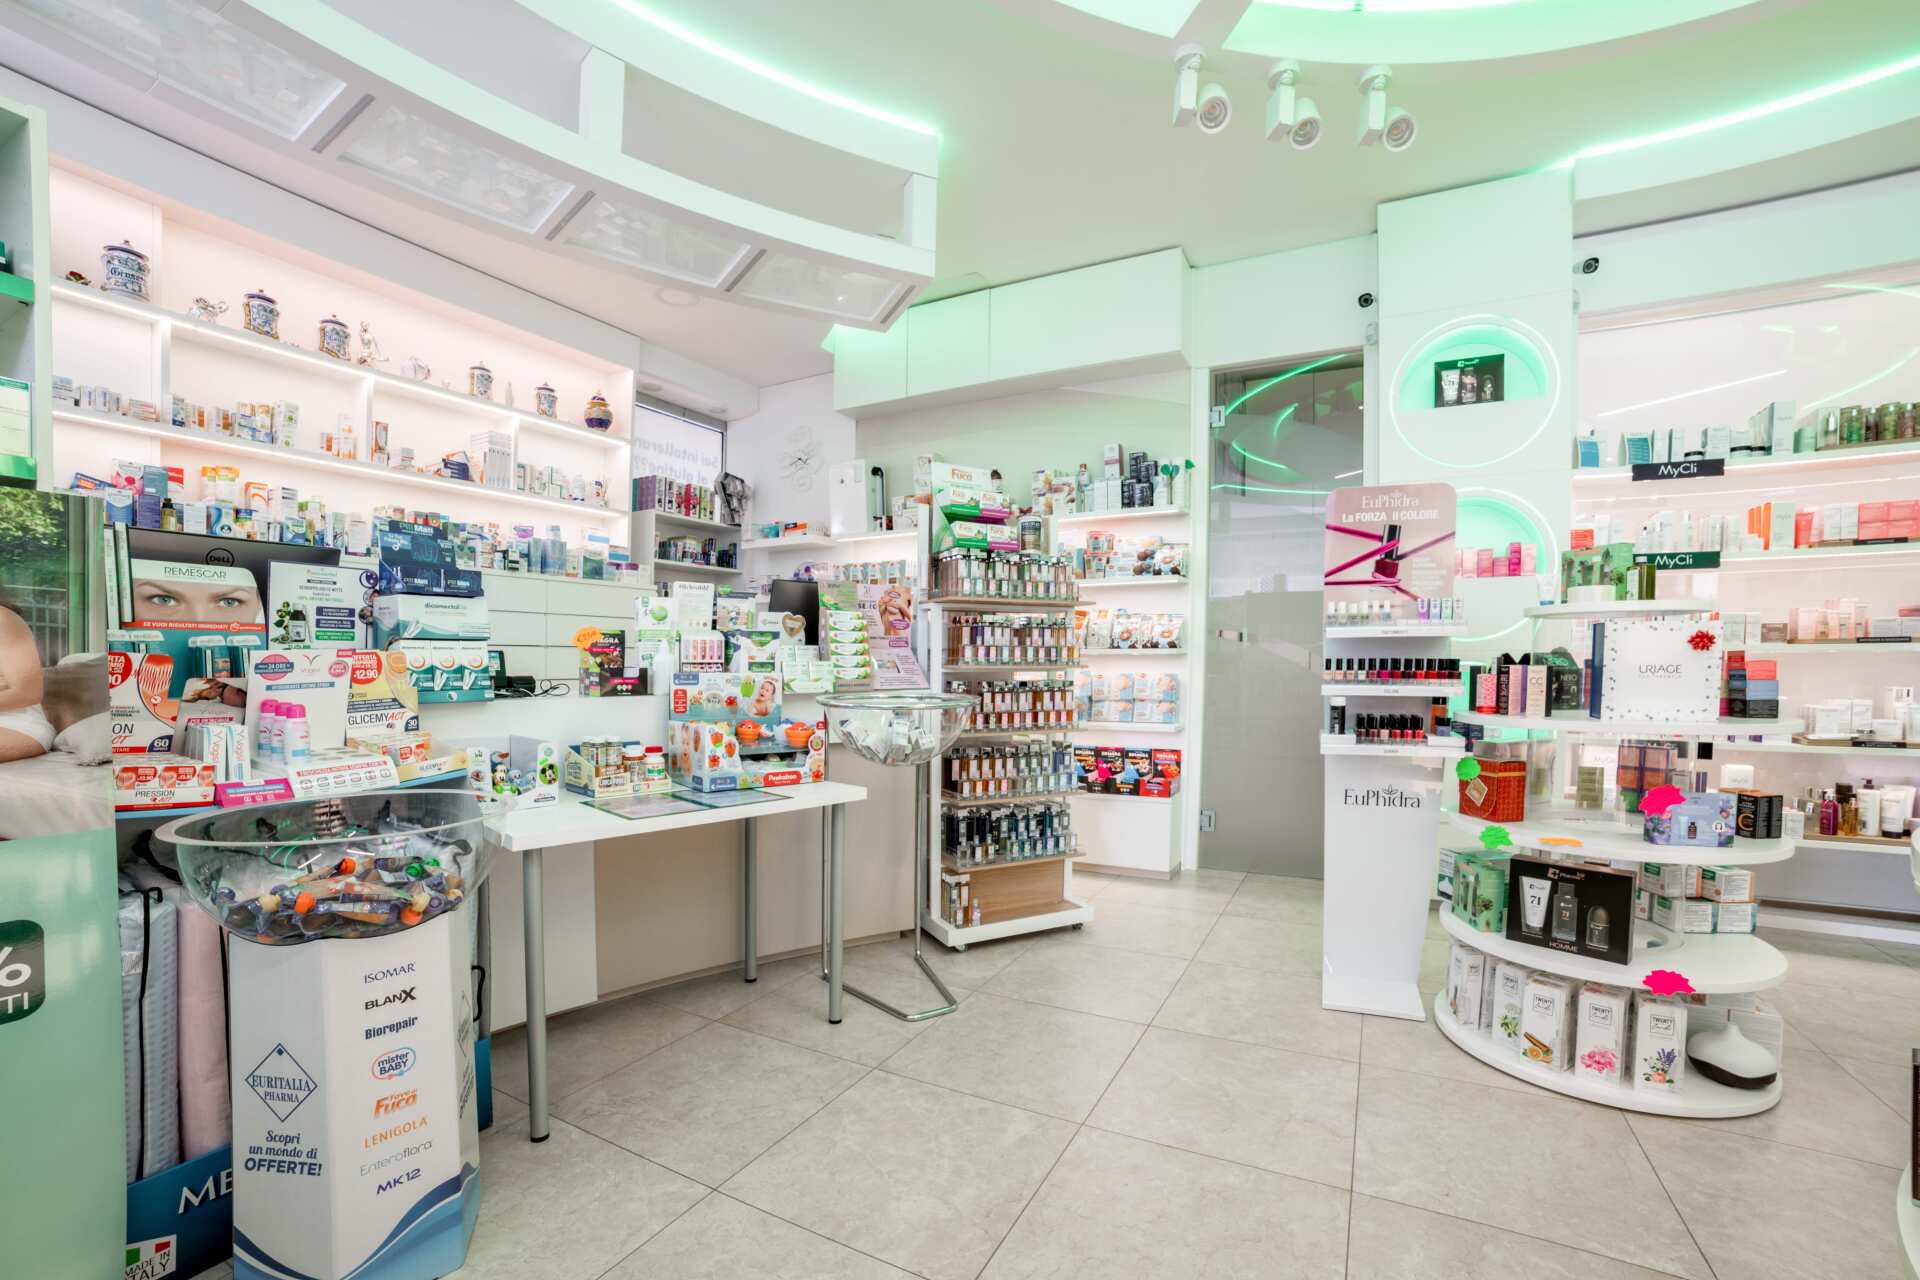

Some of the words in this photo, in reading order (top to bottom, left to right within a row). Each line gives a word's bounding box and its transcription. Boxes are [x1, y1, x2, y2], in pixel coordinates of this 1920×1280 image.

[1658, 463, 1697, 477] MyCli
[1362, 494, 1419, 509] EuPhidra
[1342, 513, 1354, 523] La
[1355, 511, 1386, 522] FORZA
[1400, 509, 1439, 520] COLORE
[1655, 554, 1693, 568] MyCli
[164, 566, 227, 579] REMESCAR
[1639, 664, 1681, 674] URIAGE
[1529, 677, 1543, 685] CC
[154, 739, 169, 747] 60
[135, 789, 175, 798] PRESSION
[1344, 788, 1421, 809] EuPhidra
[1530, 895, 1541, 905] 71
[1549, 941, 1578, 952] HOMME
[364, 963, 416, 984] ISOMAR
[364, 986, 416, 1010] BLANX
[365, 1016, 418, 1040] Biorepair
[377, 1051, 410, 1067] mister
[379, 1059, 409, 1075] BABY
[251, 1074, 312, 1092] EURITALIA
[264, 1091, 300, 1103] PHARMA
[373, 1093, 417, 1119] Fuca
[265, 1129, 301, 1146] Scopri
[363, 1115, 428, 1150] LENIGOLA
[248, 1145, 263, 1155] un
[265, 1145, 303, 1158] mondo
[306, 1147, 318, 1160] di
[360, 1140, 433, 1177] Enteroflora
[244, 1157, 323, 1177] OFFERTE!
[125, 1257, 153, 1277] MADE
[159, 1250, 171, 1261] IN
[125, 1258, 171, 1280] TALY
